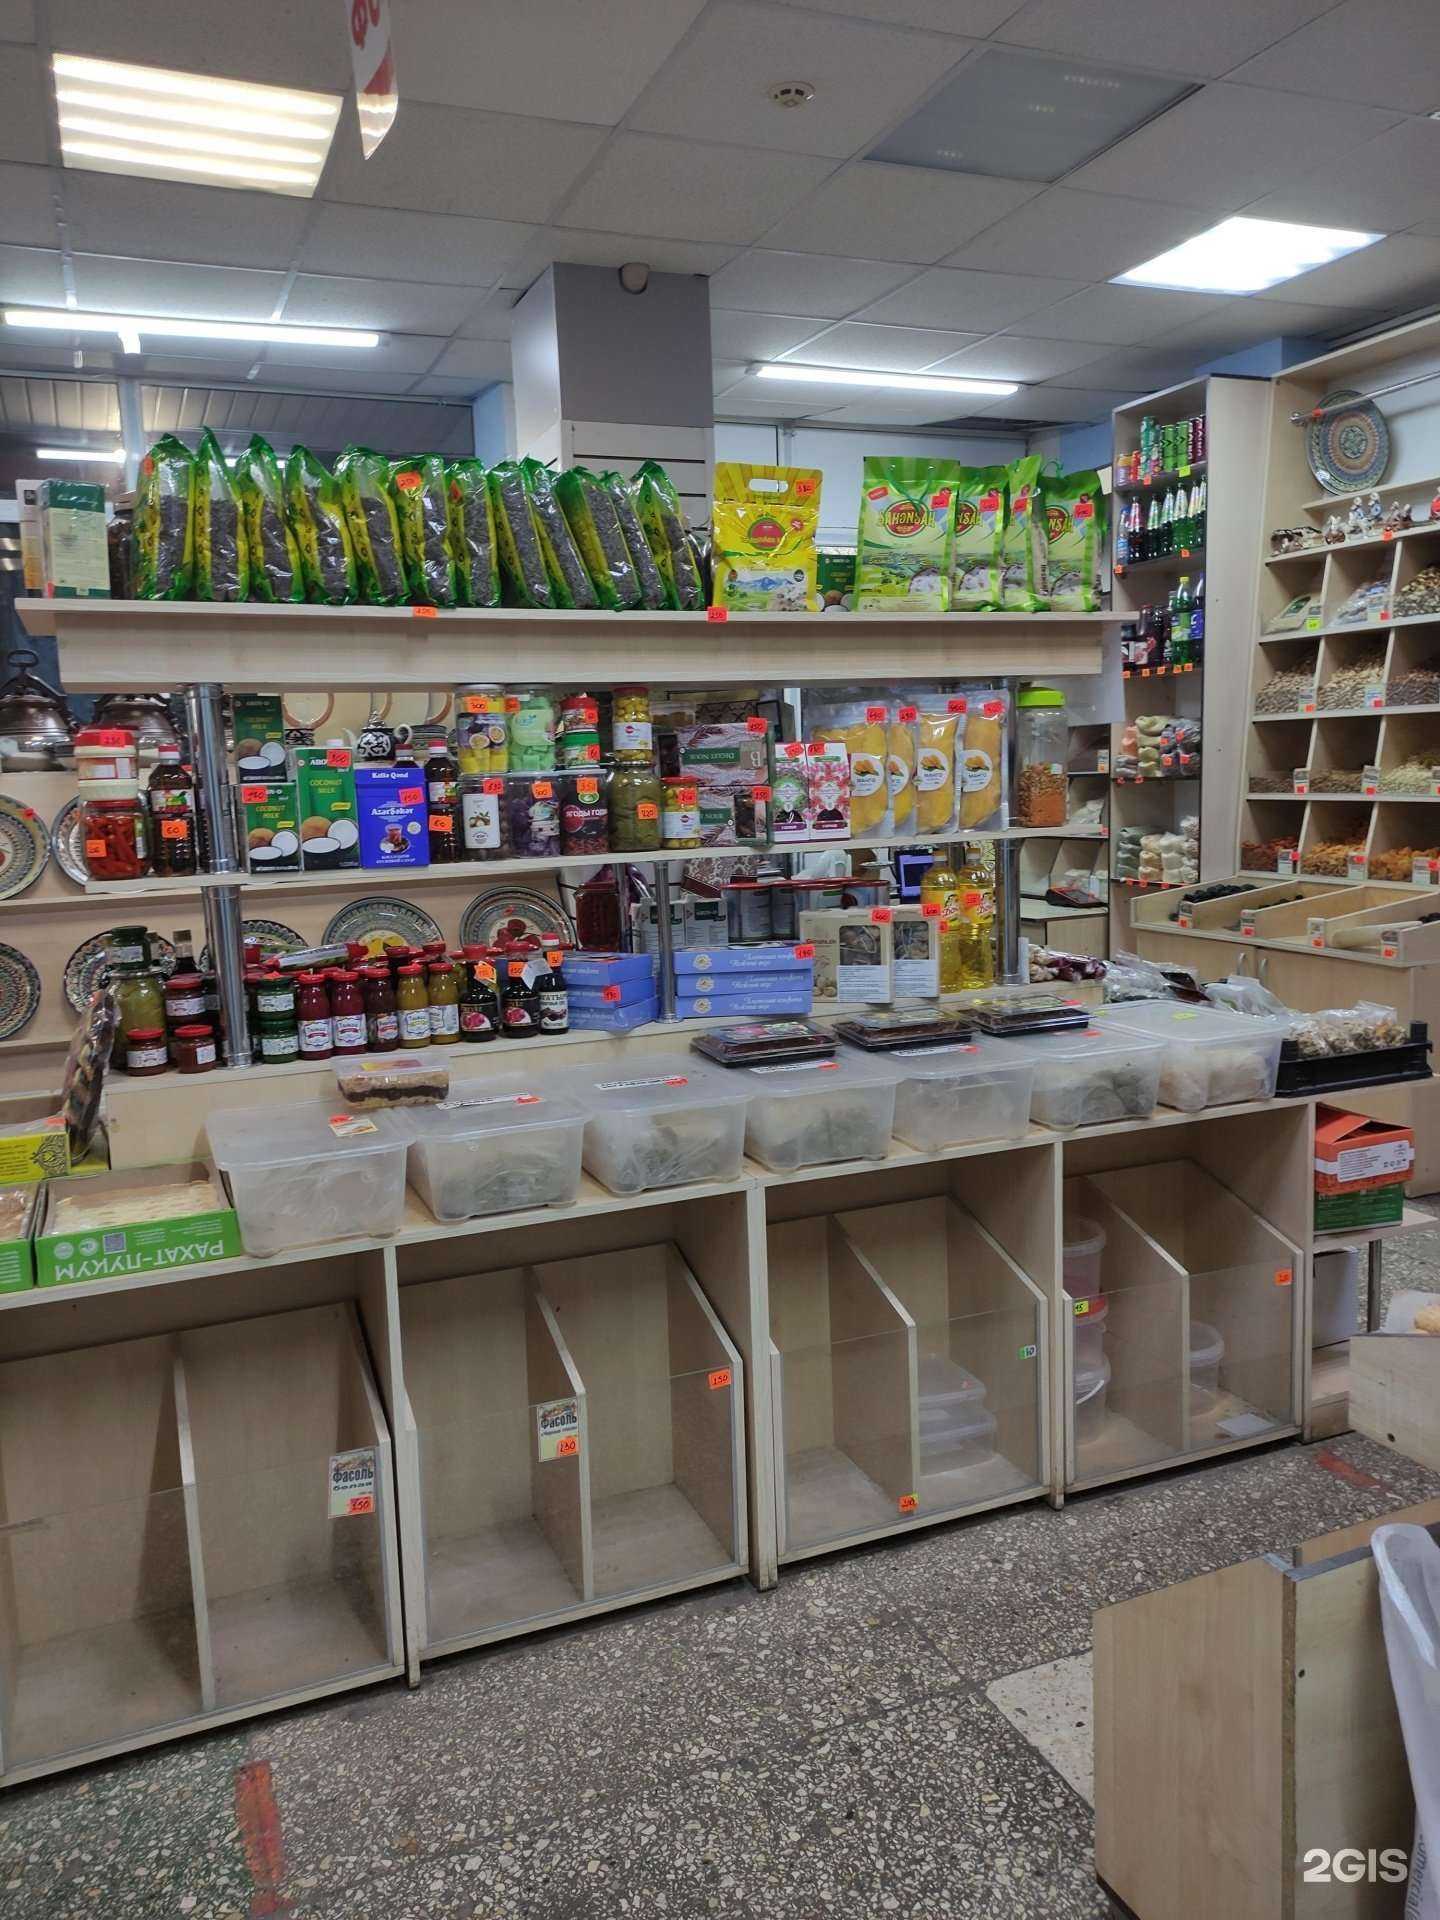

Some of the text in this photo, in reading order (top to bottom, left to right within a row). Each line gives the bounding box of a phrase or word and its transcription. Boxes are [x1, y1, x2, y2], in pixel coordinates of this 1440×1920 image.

[55, 1239, 224, 1281] РАХАТ-ЛУКУМ
[541, 1414, 577, 1430] Фасоль
[333, 1468, 374, 1484] Фасоль
